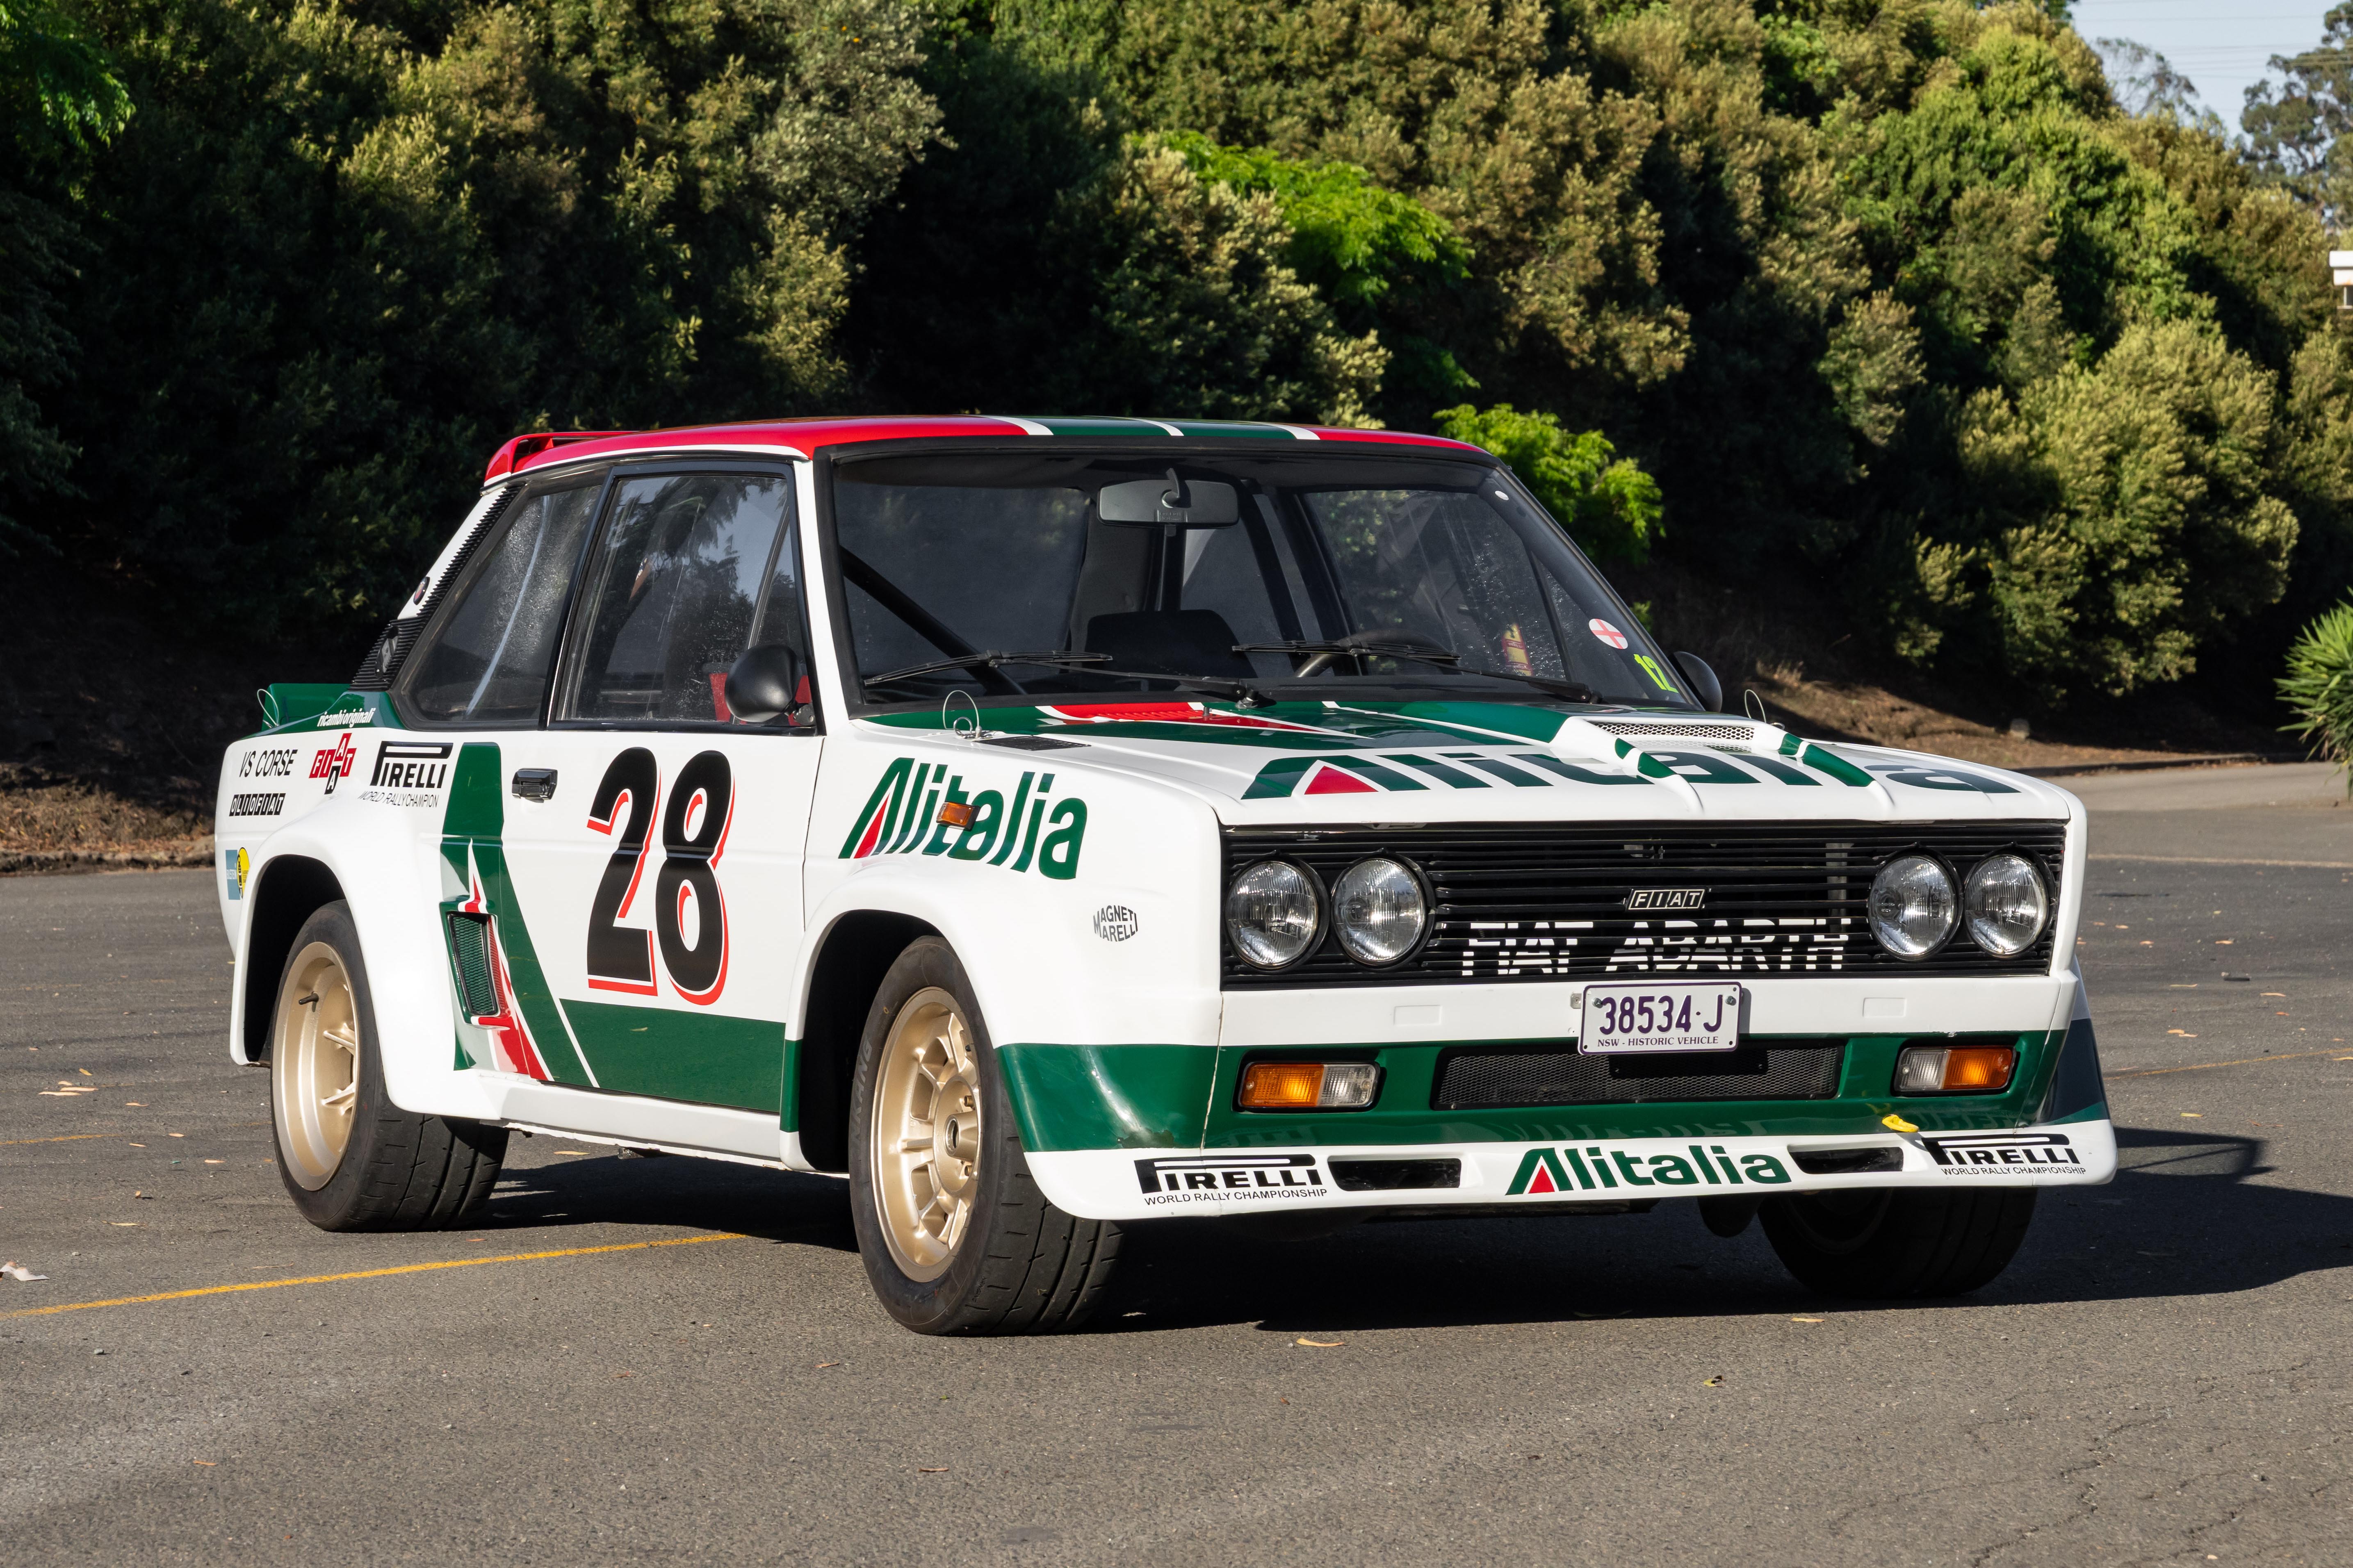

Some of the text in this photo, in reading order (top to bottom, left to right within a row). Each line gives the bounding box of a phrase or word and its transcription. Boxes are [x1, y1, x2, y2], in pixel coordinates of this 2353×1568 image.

[1634, 654, 1678, 693] 12
[239, 749, 298, 777] VS CORSE
[370, 741, 453, 788] PIRELLI
[838, 758, 1088, 880] Alitalia
[587, 747, 735, 1005] 28
[1634, 892, 1701, 907] FIAT
[1093, 905, 1138, 930] MAGNETI
[1093, 917, 1138, 941] MARELLI
[1462, 918, 1851, 976] FIAT ABARTH
[1598, 1038, 1619, 1046] NSW
[1628, 1037, 1674, 1046] HISTORIC
[1678, 1036, 1719, 1045] VEHICLE
[1921, 1134, 2080, 1165] PIRELLI
[1134, 1154, 1323, 1194] PIRELLI
[1505, 1145, 1792, 1196] Alitalia
[1941, 1166, 2086, 1176] WORLD RALLY CHAMPIONSHIP
[1145, 1188, 1327, 1206] WORLD RALLY CHAMPIONSHIP
